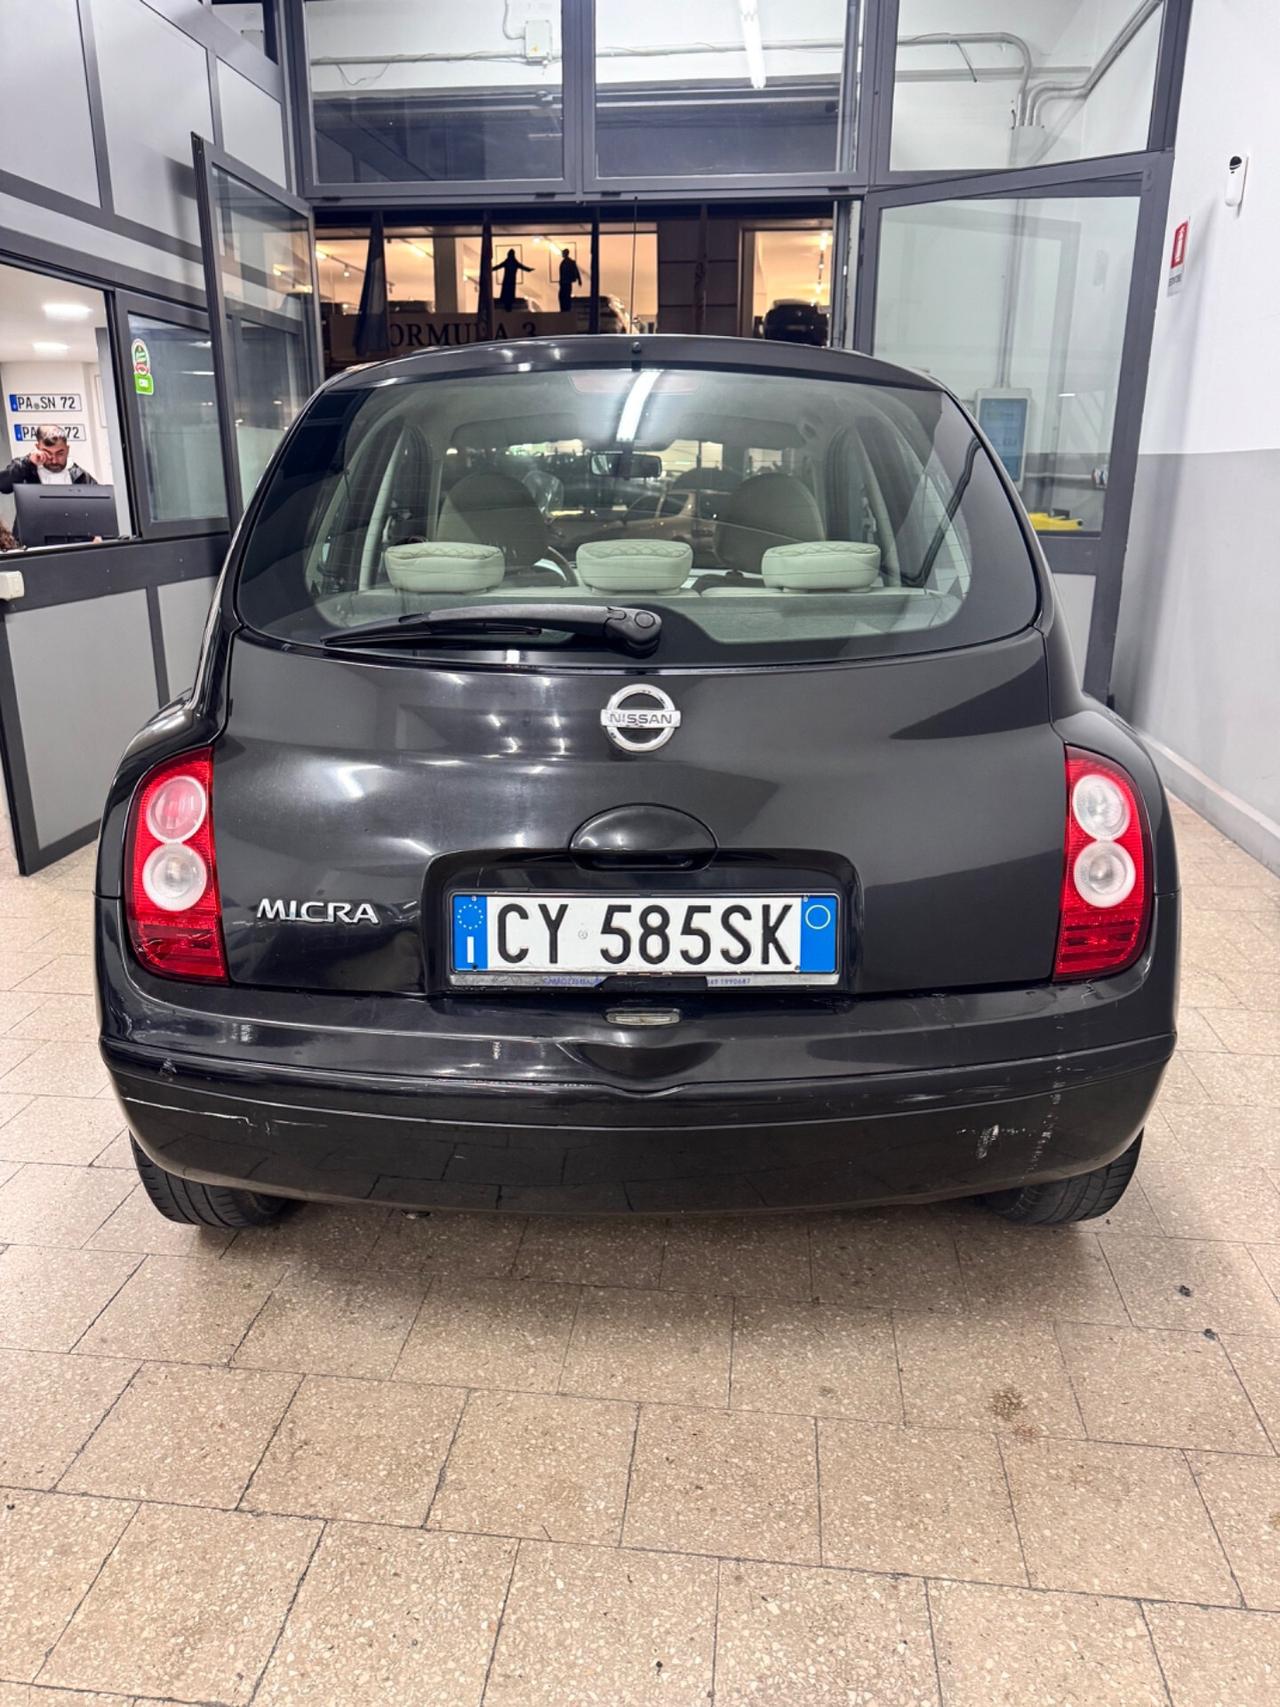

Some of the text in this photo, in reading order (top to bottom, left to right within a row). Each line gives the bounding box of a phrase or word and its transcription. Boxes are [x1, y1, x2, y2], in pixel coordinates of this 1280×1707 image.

[390, 322, 509, 347] ORMUA
[17, 396, 76, 409] PA SN 72
[64, 426, 80, 439] 72
[609, 713, 673, 725] NISSAN
[256, 898, 379, 923] MICRA
[497, 903, 569, 965] CY
[600, 904, 793, 966] 585SK
